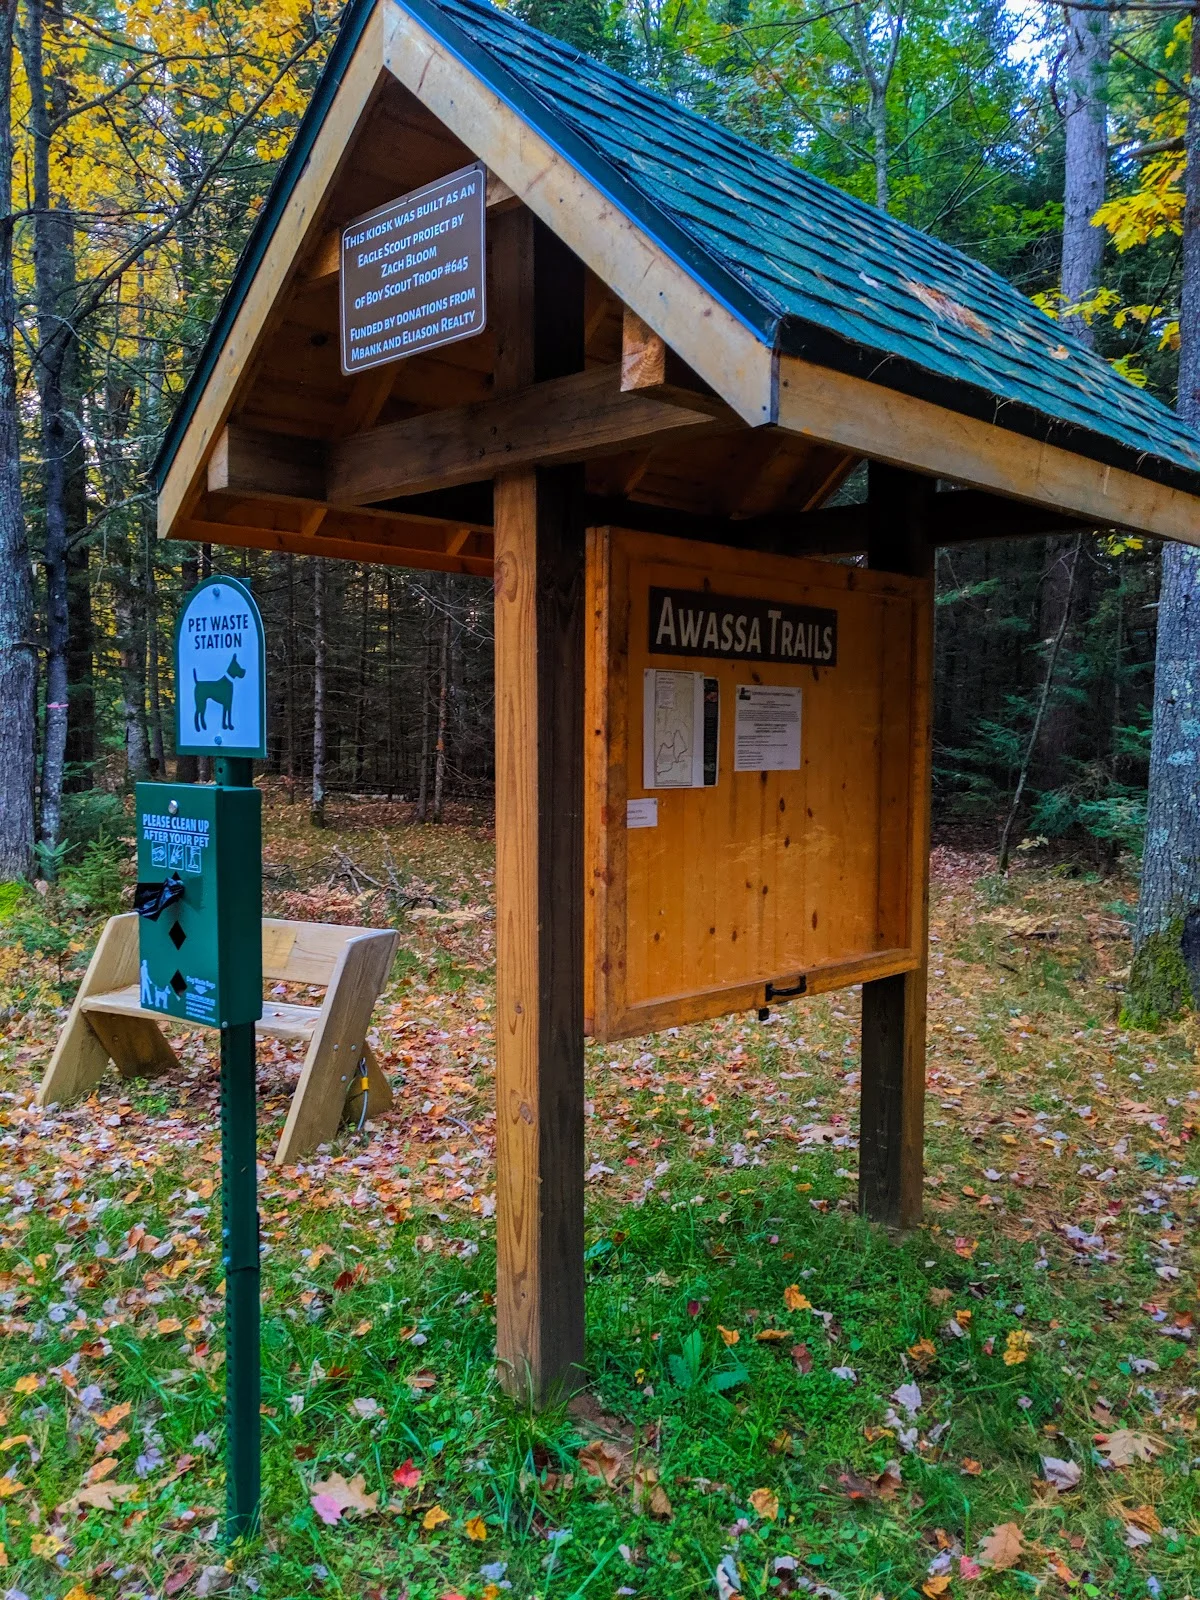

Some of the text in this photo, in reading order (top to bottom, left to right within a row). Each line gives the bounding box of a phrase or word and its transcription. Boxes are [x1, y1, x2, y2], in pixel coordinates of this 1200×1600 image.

[344, 182, 476, 250] THIS KIOSK WAS BUILT AS AN
[357, 213, 465, 268] EAGLE SCOUT PROJECT BY
[354, 256, 469, 310] OF BOY SCOUT TROOP #645
[381, 246, 437, 278] ZACH BLOOM
[350, 287, 476, 342] FUNDED BY DONATIONS FROM
[351, 310, 476, 362] MBANK AND ELIASON REALTY
[188, 613, 249, 633] PET WASTE
[194, 632, 242, 650] STATION
[656, 596, 833, 660] AWASSA TRAILS
[142, 813, 210, 833] PLEASE CLEAN UP
[143, 829, 210, 848] AFTER YOUR PET
